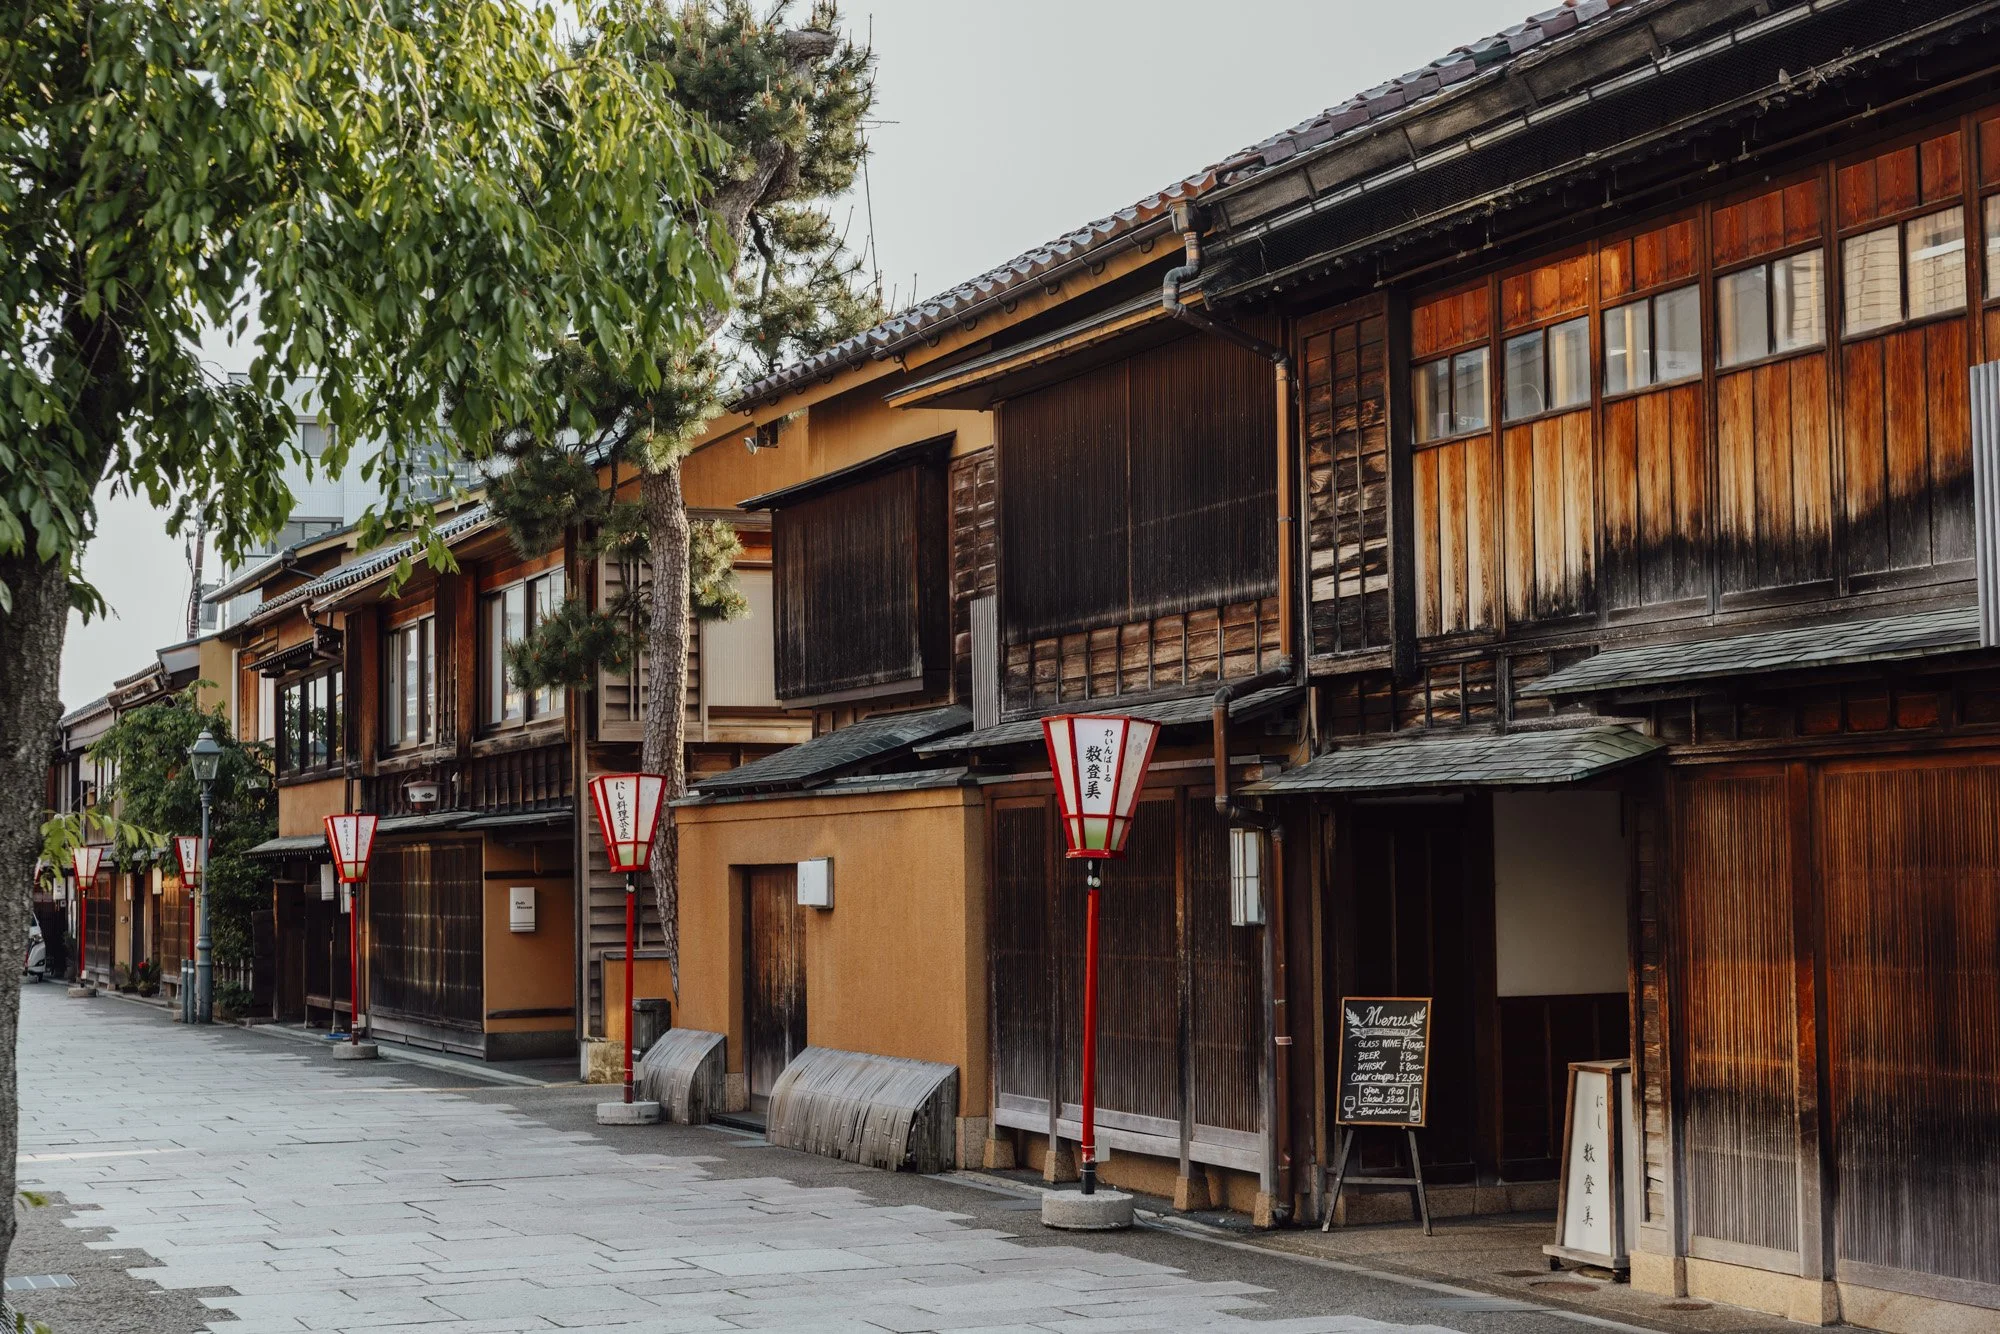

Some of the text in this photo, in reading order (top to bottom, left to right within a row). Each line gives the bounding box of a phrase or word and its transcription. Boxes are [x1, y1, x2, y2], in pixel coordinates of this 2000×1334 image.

[1103, 728, 1114, 783] わいんばーる
[1084, 745, 1103, 800] 数登美
[1361, 1006, 1409, 1027] Menu
[1357, 1040, 1380, 1048] GLASS
[1382, 1039, 1402, 1048] WINE
[1357, 1061, 1387, 1071] WHISKY
[1358, 1050, 1381, 1061] BEER
[1362, 1093, 1384, 1103] closed
[1596, 1095, 1604, 1130] にし
[1582, 1143, 1595, 1228] 数登美
